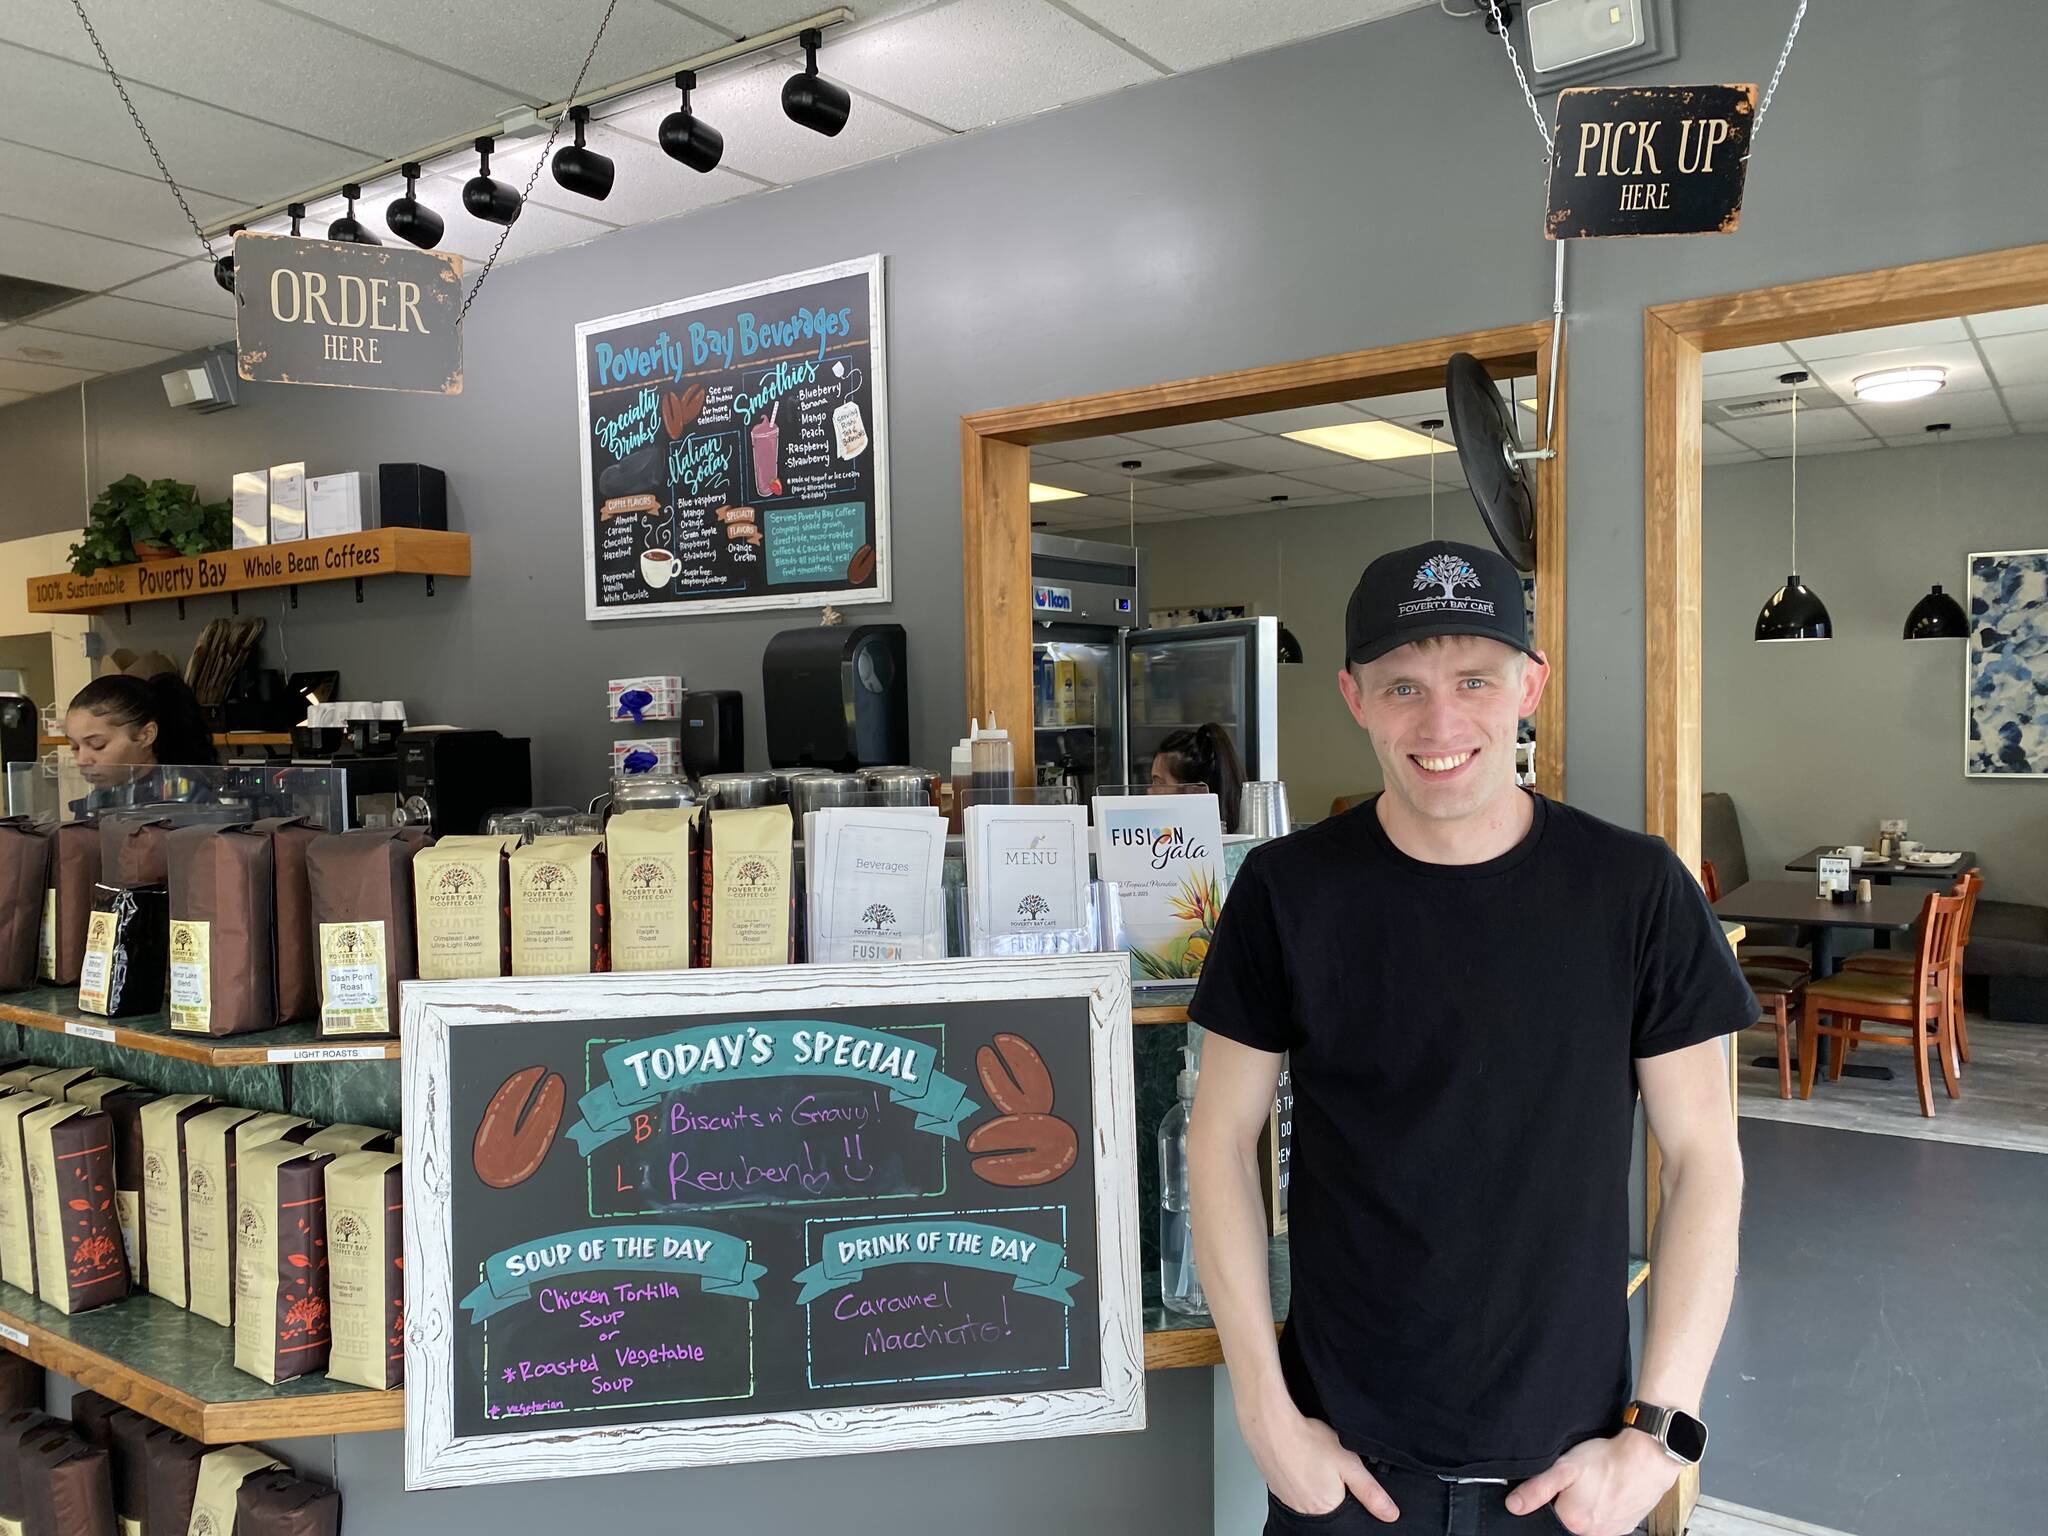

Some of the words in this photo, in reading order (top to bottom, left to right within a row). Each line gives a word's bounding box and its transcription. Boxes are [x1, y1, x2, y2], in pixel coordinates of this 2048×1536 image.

[1574, 120, 1662, 177] PICK
[1678, 119, 1730, 174] UP
[1619, 183, 1671, 211] HERE
[270, 268, 431, 334] ORDER
[323, 334, 383, 364] HERE
[595, 331, 684, 385] Poverty
[688, 321, 735, 369] Bay
[737, 307, 852, 361] Beverages
[708, 386, 721, 396] See
[733, 360, 820, 426] Smoothies
[799, 382, 842, 401] Blueberry
[705, 396, 716, 404] full
[716, 394, 733, 403] menu
[800, 398, 828, 411] Banana
[594, 385, 660, 448] Specialty
[697, 410, 732, 425] selections!
[702, 407, 712, 415] for
[712, 405, 728, 414] more
[801, 412, 827, 425] Mango
[608, 416, 662, 461] Drinks
[801, 425, 825, 440] Peach
[788, 440, 830, 455] Raspberry
[667, 432, 723, 488] Italian
[787, 455, 830, 468] Strawberry
[684, 444, 733, 495] Sodas
[608, 499, 626, 510] COFFEE
[627, 496, 652, 508] FLAVORS
[677, 497, 693, 509] Blue
[694, 492, 727, 507] raspberry
[615, 512, 638, 526] Almond
[682, 508, 705, 519] Mango
[726, 509, 754, 521] SPECIALTY
[769, 512, 798, 524] Serving
[798, 510, 821, 522] Poverty
[822, 509, 834, 519] Bay
[835, 507, 857, 517] Coffee
[607, 524, 632, 537] Caramel
[680, 518, 704, 529] Orange
[729, 526, 754, 535] FLAVORS
[682, 530, 700, 540] Green
[701, 526, 718, 538] Apple
[603, 535, 634, 549] Chocolate
[679, 538, 711, 550] Raspberry
[727, 543, 752, 554] Orange
[604, 546, 632, 561] Hazelnut
[683, 550, 717, 562] Strawberry
[733, 552, 757, 563] Cream
[36, 581, 63, 603] 100%
[66, 574, 125, 599] Sustainable
[138, 564, 194, 595] Poverty
[198, 558, 227, 588] Bay
[243, 555, 282, 579] Whole
[288, 551, 319, 574] Bean
[324, 543, 380, 569] Coffees
[602, 569, 636, 584] Peppermint
[603, 583, 624, 593] Vanilla
[603, 592, 621, 603] White
[621, 589, 650, 600] Chocolate
[1047, 590, 1071, 609] Ikon
[1399, 600, 1448, 615] POVERTY
[1449, 600, 1469, 609] BAY
[1004, 852, 1058, 866] MENU
[1151, 837, 1209, 870] Gala
[856, 858, 910, 873] Beverages
[430, 894, 465, 902] POVERTY
[330, 974, 350, 982] Dash
[352, 973, 373, 981] Point
[340, 983, 363, 991] Roast
[294, 1051, 320, 1059] LIGHT
[322, 1049, 359, 1058] ROASTS
[622, 1026, 776, 1088] TODAY'S
[792, 1030, 921, 1085] SPECIAL
[670, 1101, 766, 1136] Biscuits
[791, 1089, 882, 1128] Gravy!
[838, 1232, 912, 1265] DRINK
[916, 1231, 943, 1252] OF
[947, 1231, 983, 1255] THE
[989, 1235, 1038, 1265] DAY
[505, 1242, 573, 1277] SOUP
[578, 1238, 607, 1263] OF
[612, 1236, 658, 1260] THE
[663, 1237, 714, 1264] DAY
[538, 1287, 609, 1313] Chicken
[613, 1281, 680, 1303] Tortilla
[833, 1280, 953, 1321] Caramel
[579, 1308, 626, 1330] Soup
[598, 1330, 621, 1343] or
[614, 1343, 706, 1369] Vegetable
[591, 1375, 635, 1396] Soup
[506, 1398, 564, 1417] vegetarian
